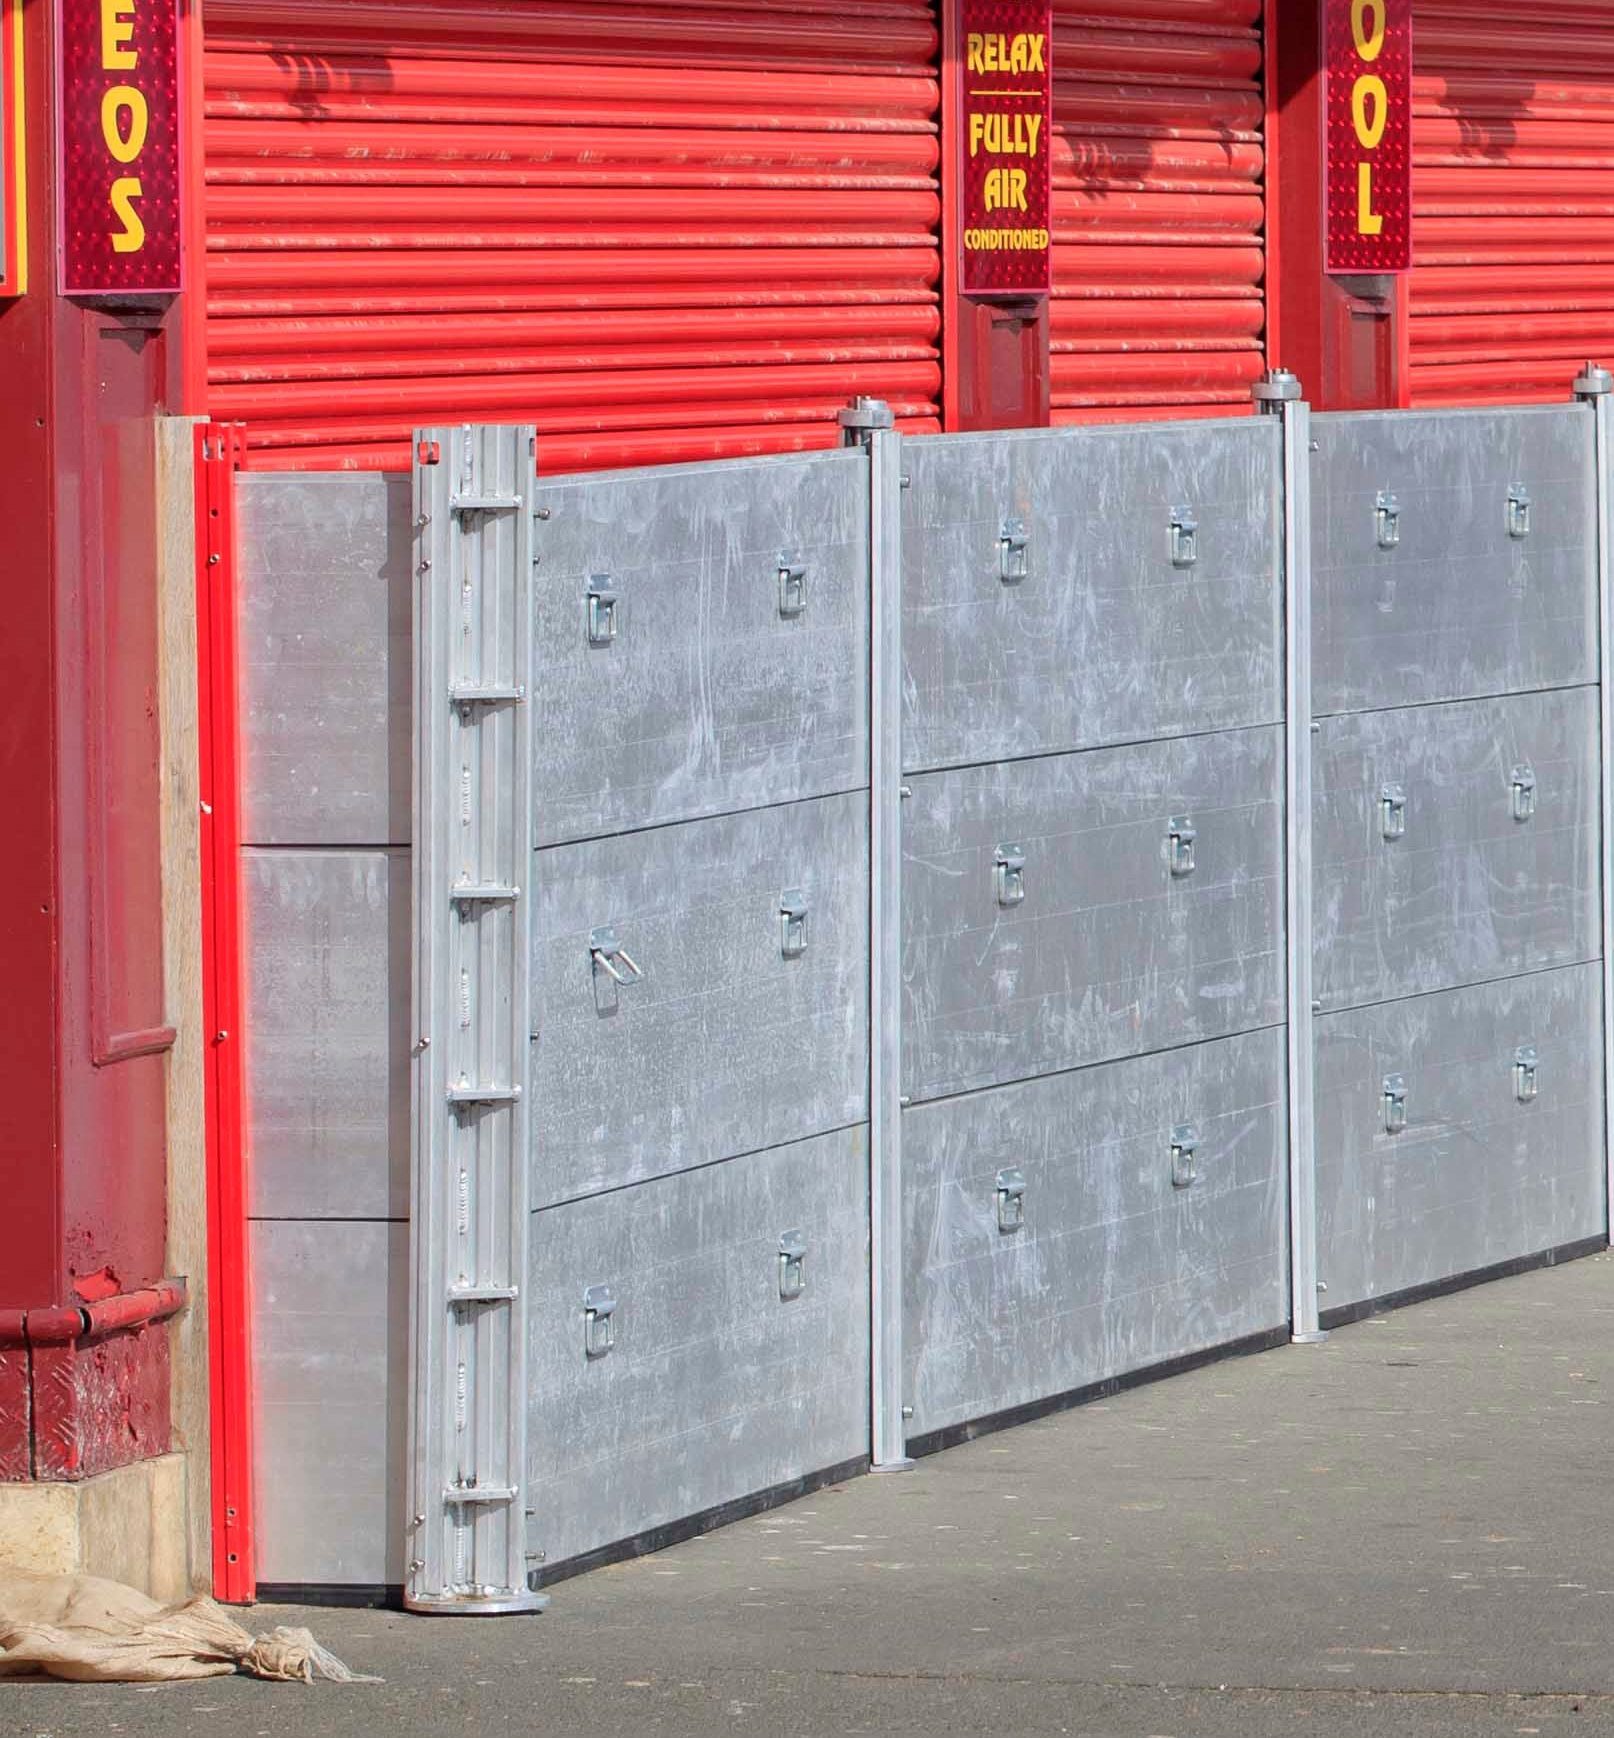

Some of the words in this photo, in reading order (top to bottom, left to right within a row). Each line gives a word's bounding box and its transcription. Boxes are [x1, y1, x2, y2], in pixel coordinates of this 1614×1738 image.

[967, 32, 1045, 75] RELAX
[969, 113, 1042, 158] FULLY
[984, 169, 1028, 213] AIR
[963, 228, 1050, 252] CONDITIONED
